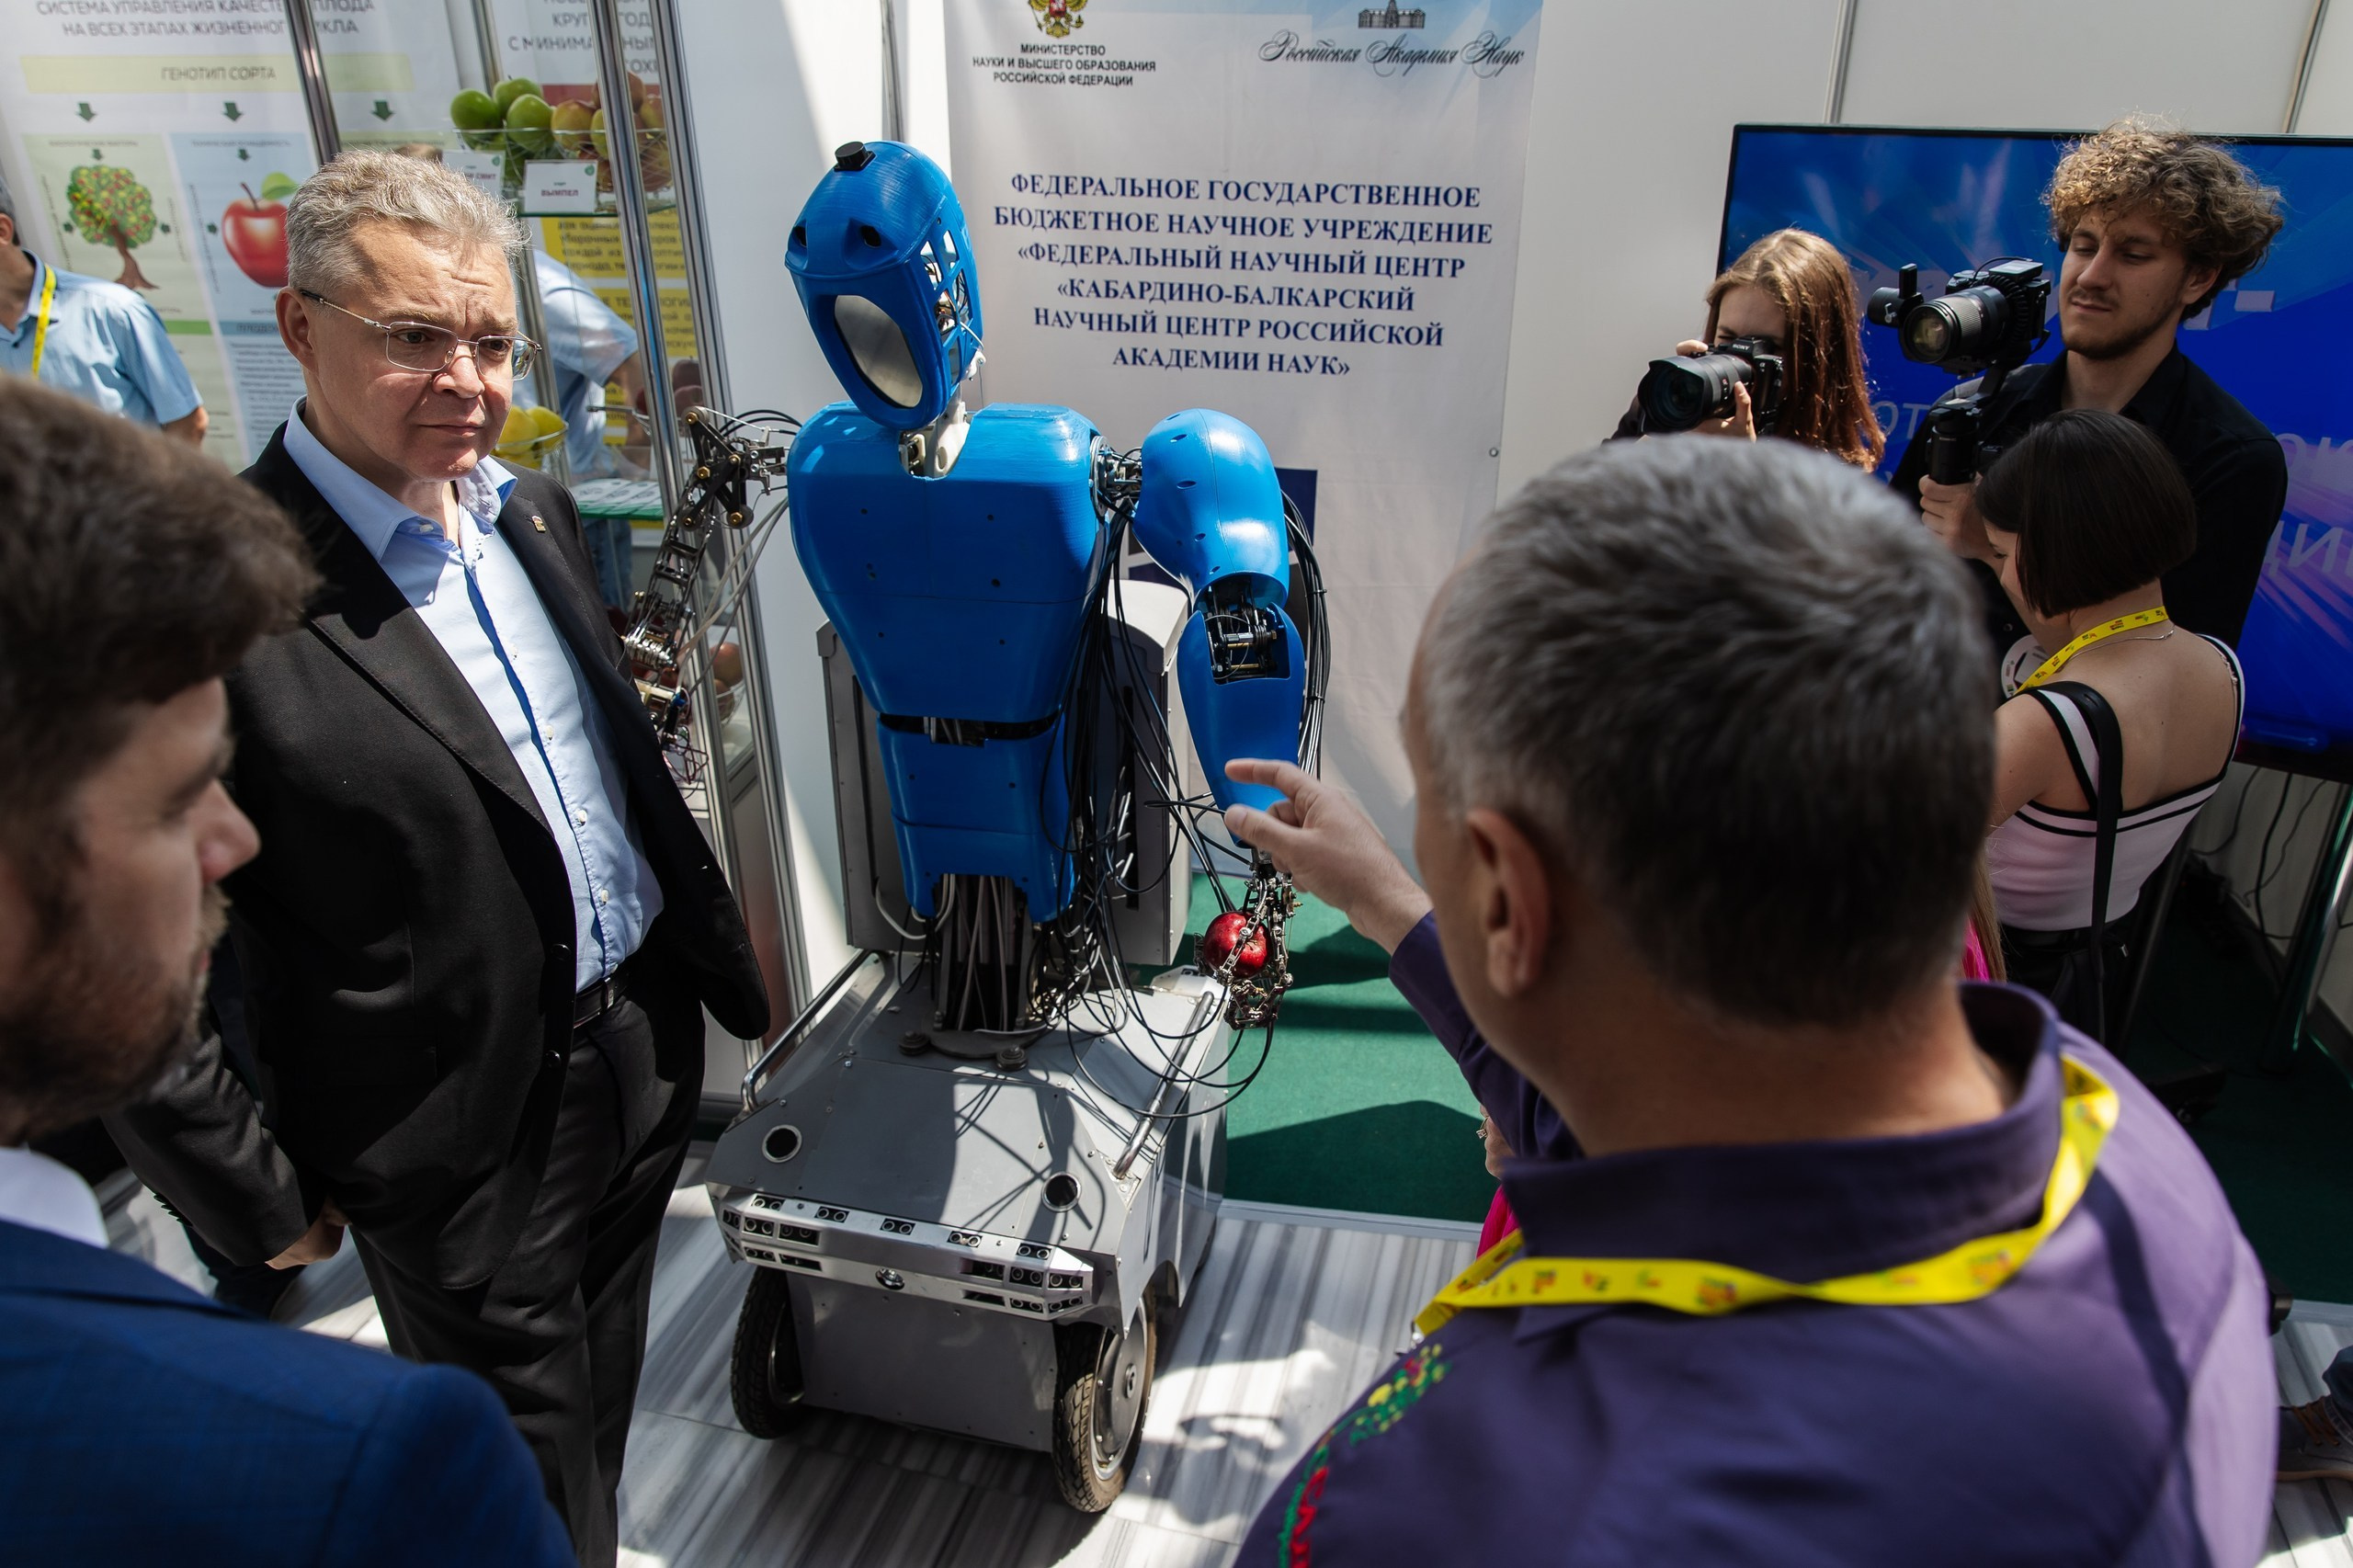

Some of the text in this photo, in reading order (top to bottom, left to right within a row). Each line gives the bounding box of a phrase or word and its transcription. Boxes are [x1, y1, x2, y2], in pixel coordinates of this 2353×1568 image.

[36, 0, 109, 16] СИСТЕМА
[111, 0, 216, 15] УПРАВЛЕНИЯ
[62, 22, 87, 36] НА
[88, 22, 128, 37] ВСЕХ
[130, 21, 189, 36] ЭТАПАХ
[191, 20, 286, 36] ЖИЗНЕННОГ
[1020, 43, 1106, 56] МИНИСТЕРСТВО
[1258, 28, 1525, 79] Российская Академия Наук
[161, 65, 277, 81] ГЕНОТИП СОРТА
[972, 56, 1156, 72] НАУКИ И ВЫСШЕГО ОБРАЗОВАНИЯ
[994, 71, 1133, 86] РОССИЙСКОЙ ФЕДЕРАЦИИ
[540, 188, 579, 197] ВЫМПЕЛ
[1012, 174, 1481, 208] ФЕДЕРАЛЬНОЕ ГОСУДАРСТВЕННОЕ
[995, 207, 1493, 245] БЮДЖЕТНОЕ НАУЧНОЕ УЧРЕЖДЕНИЕ
[1017, 243, 1466, 280] «ФЕДЕРАЛЬНЫЙ НАУЧНЫЙ ЦЕНТР
[1057, 278, 1415, 312] «КАБАРДИНО-БАЛКАРСКИЙ
[1034, 307, 1444, 347] НАУЧНЫЙ ЦЕНТР РОССИЙСКОЙ
[1112, 347, 1350, 376] АКАДЕМИИ НАУК»
